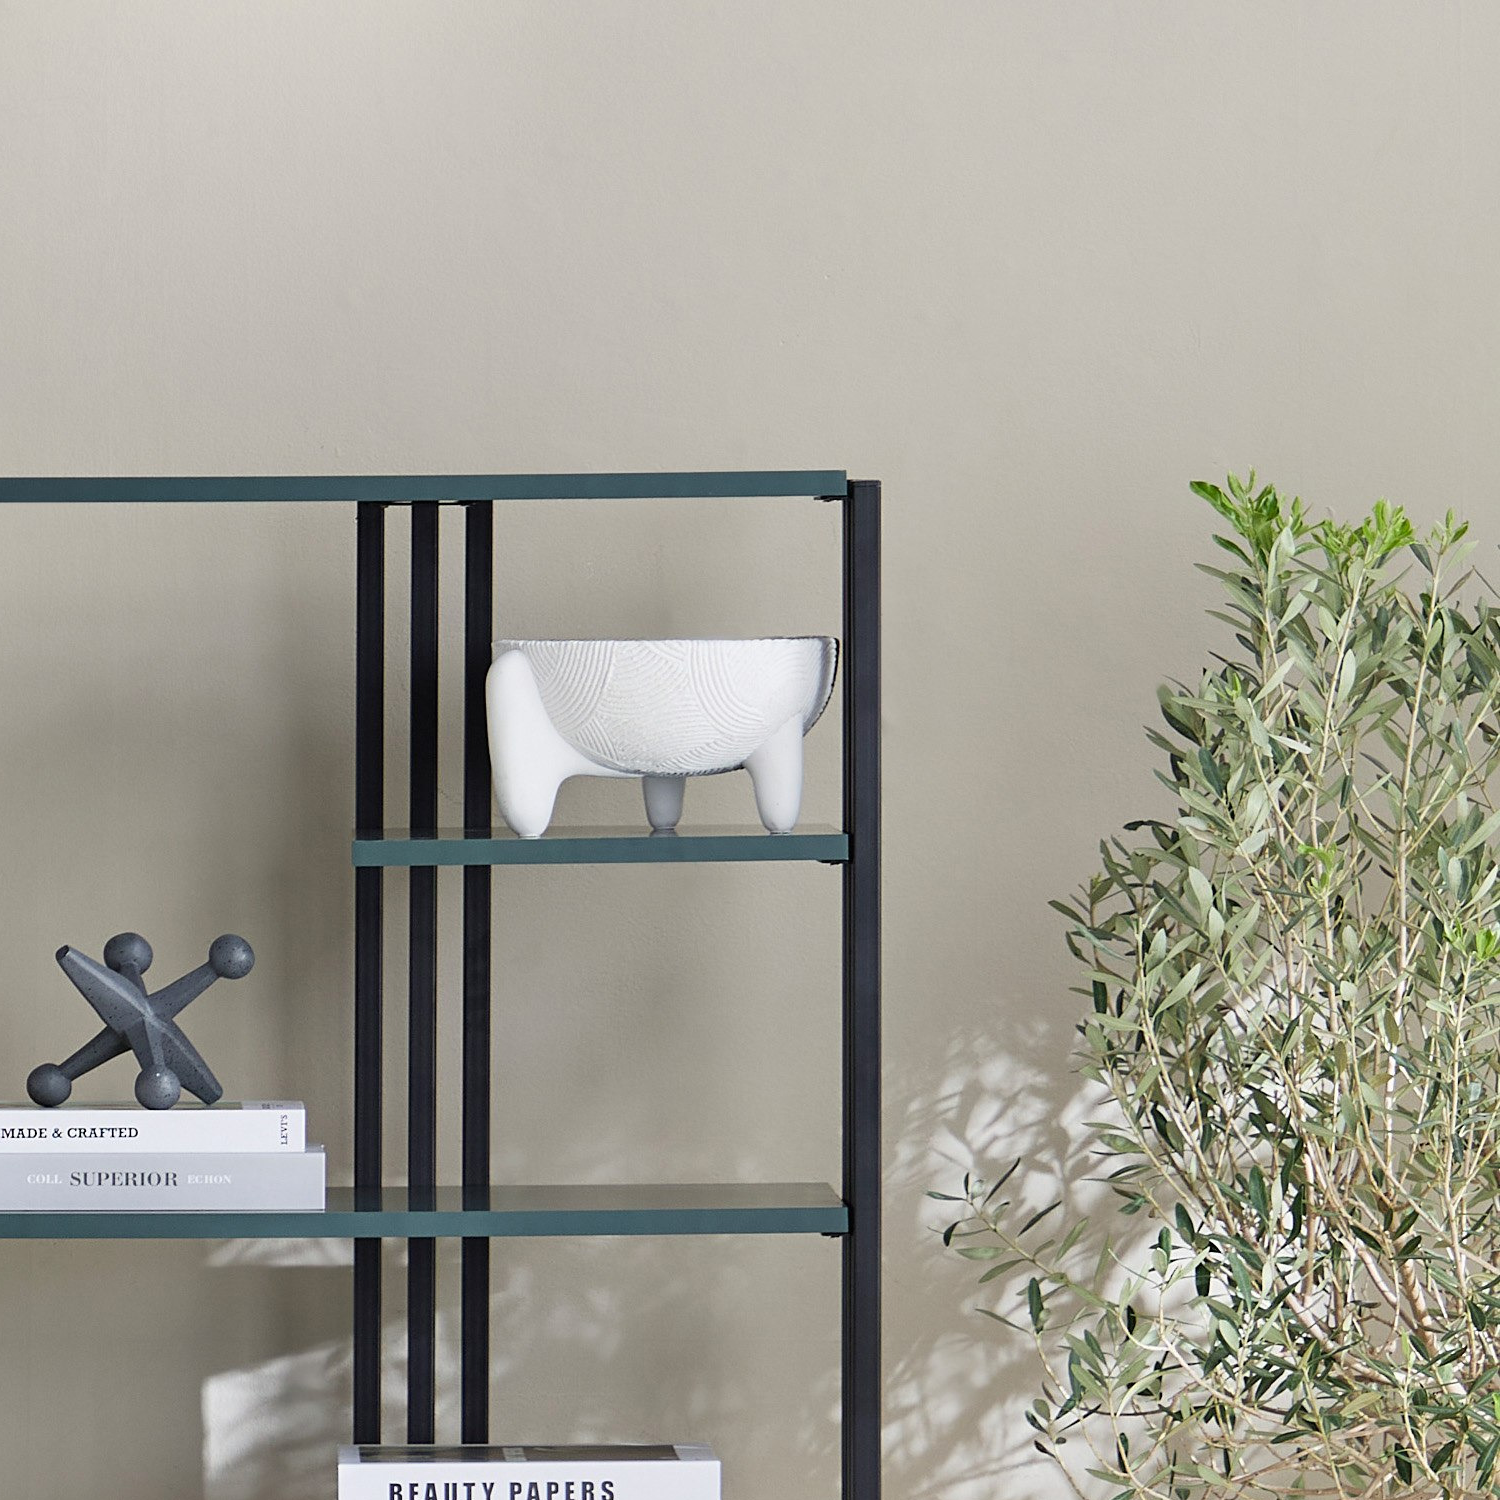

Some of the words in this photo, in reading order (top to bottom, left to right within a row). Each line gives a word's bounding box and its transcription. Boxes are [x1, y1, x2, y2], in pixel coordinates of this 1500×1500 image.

[1, 1127, 47, 1140] MADE
[51, 1128, 63, 1139] &
[67, 1127, 139, 1139] CRAFTED
[280, 1114, 288, 1145] LEVI'S
[26, 1174, 62, 1184] COLL
[70, 1171, 178, 1187] SUPERIOR
